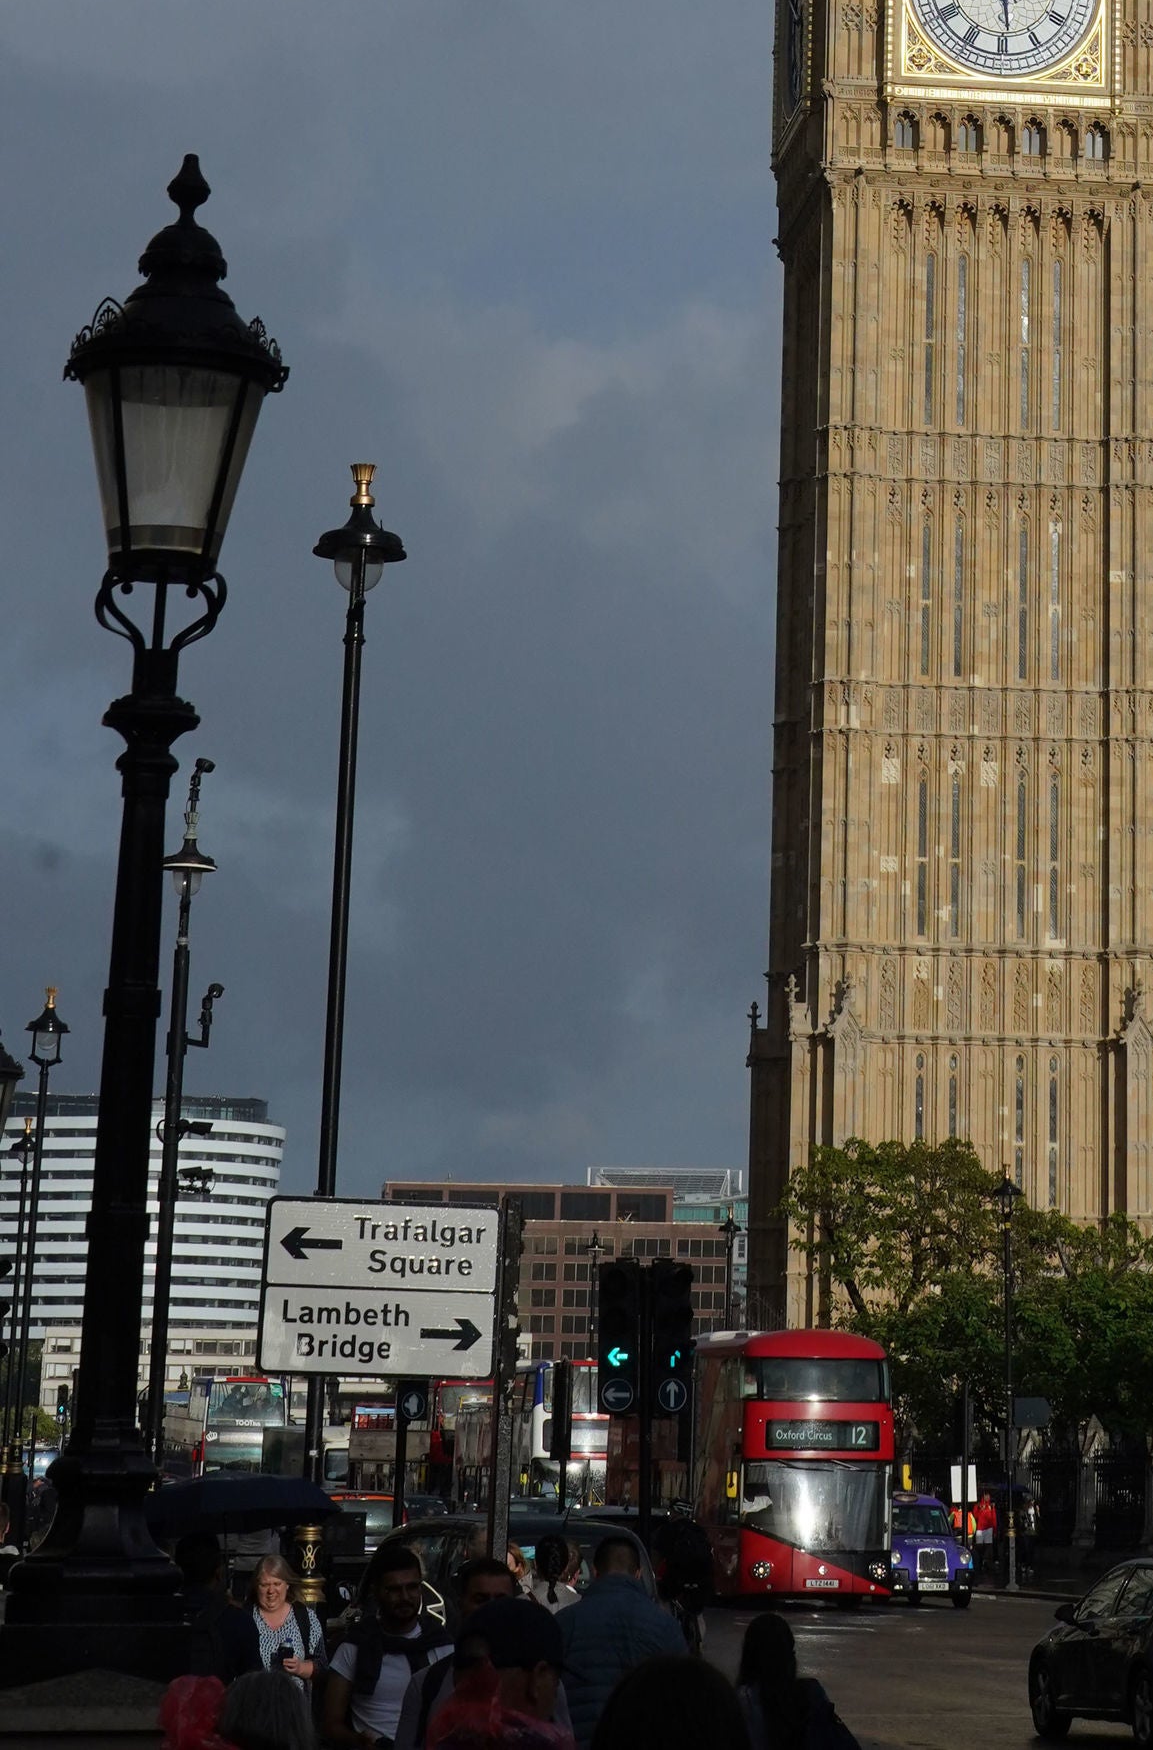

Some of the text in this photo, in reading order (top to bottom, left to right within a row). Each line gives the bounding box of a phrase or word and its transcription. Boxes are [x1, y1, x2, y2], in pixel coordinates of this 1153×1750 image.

[354, 1215, 487, 1248] Trafalgar
[367, 1249, 473, 1278] Square
[282, 1299, 411, 1327] Lambeth
[296, 1333, 391, 1364] Bridge
[775, 1426, 867, 1444] Oxford Circus 12
